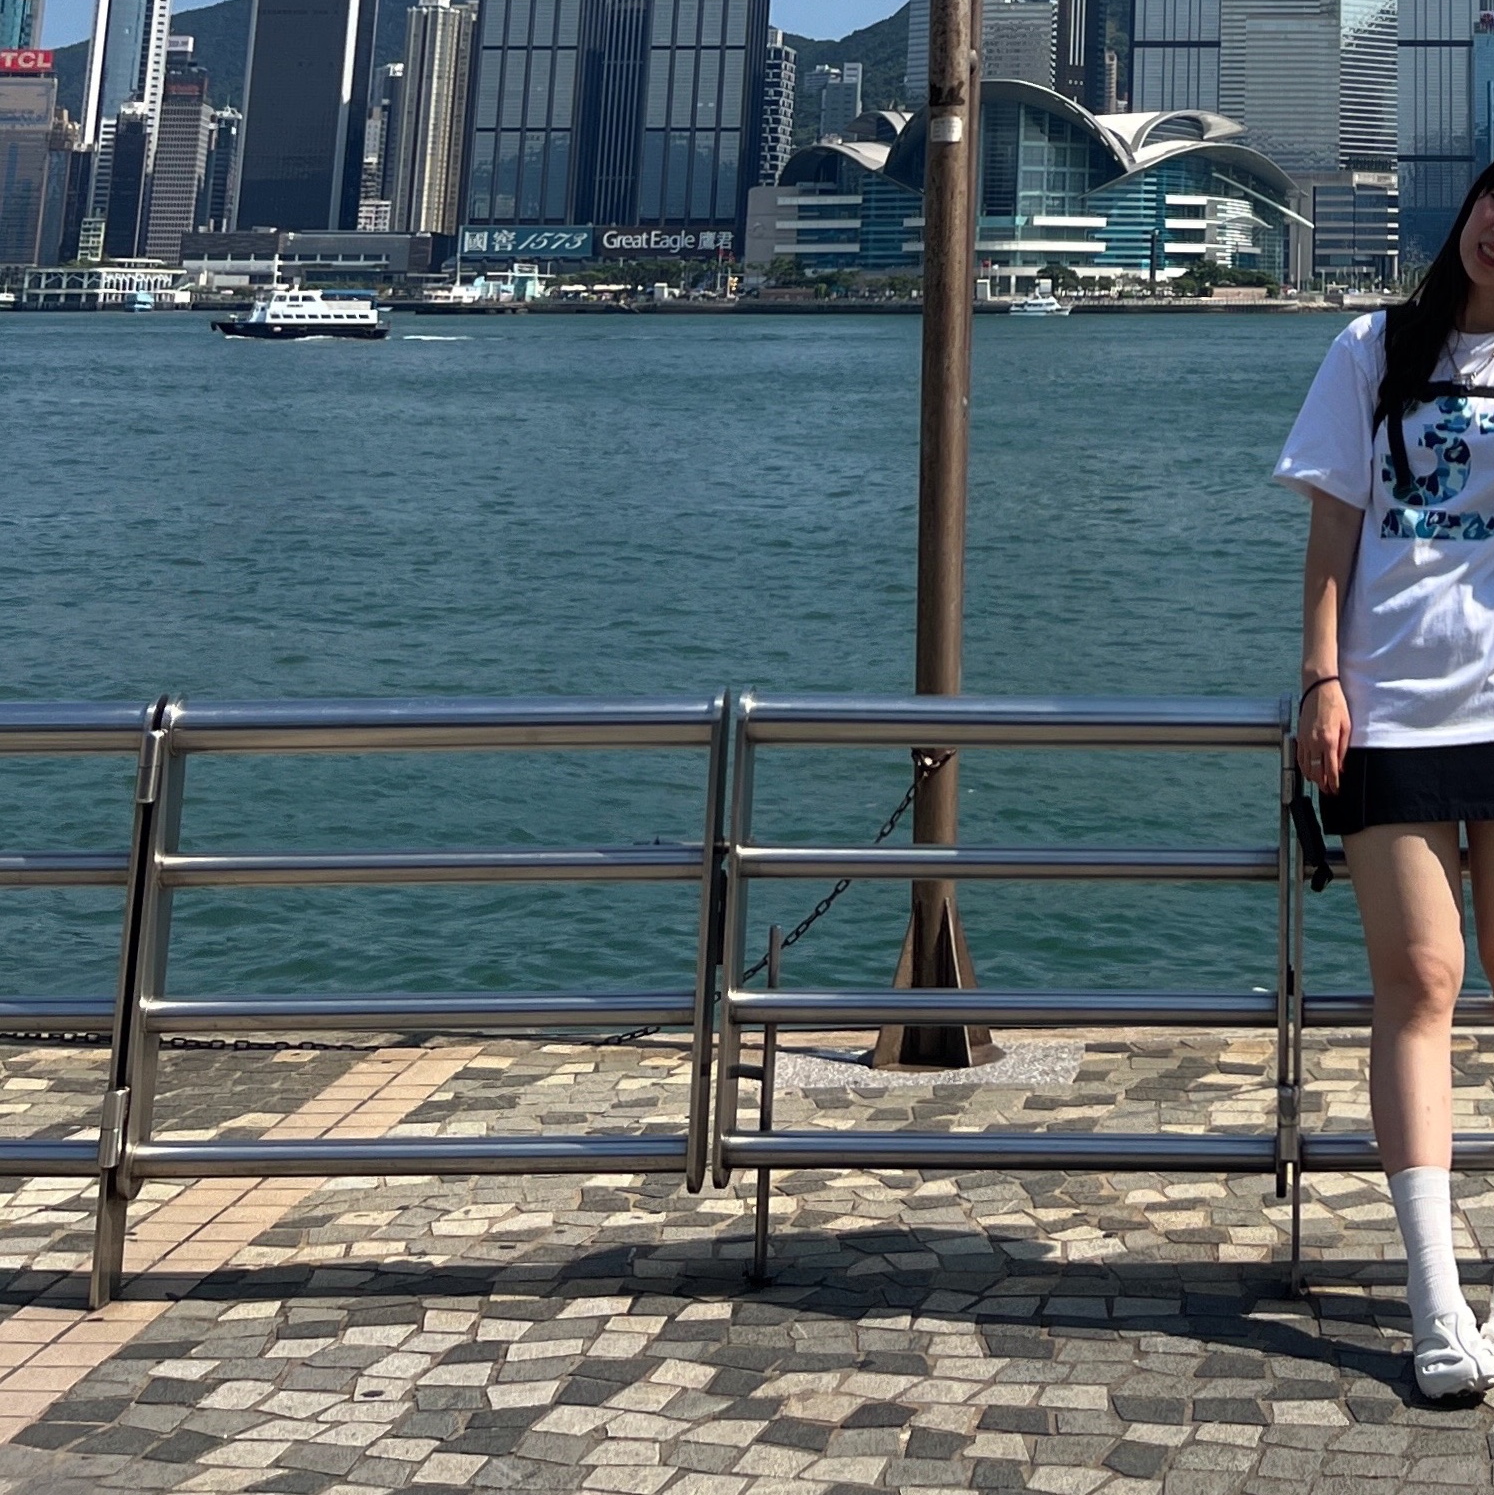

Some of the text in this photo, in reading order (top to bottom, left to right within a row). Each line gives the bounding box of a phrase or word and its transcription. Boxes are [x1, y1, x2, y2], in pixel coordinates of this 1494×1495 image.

[1, 51, 52, 68] TCL
[602, 230, 649, 249] Great
[650, 229, 696, 253] Eagle
